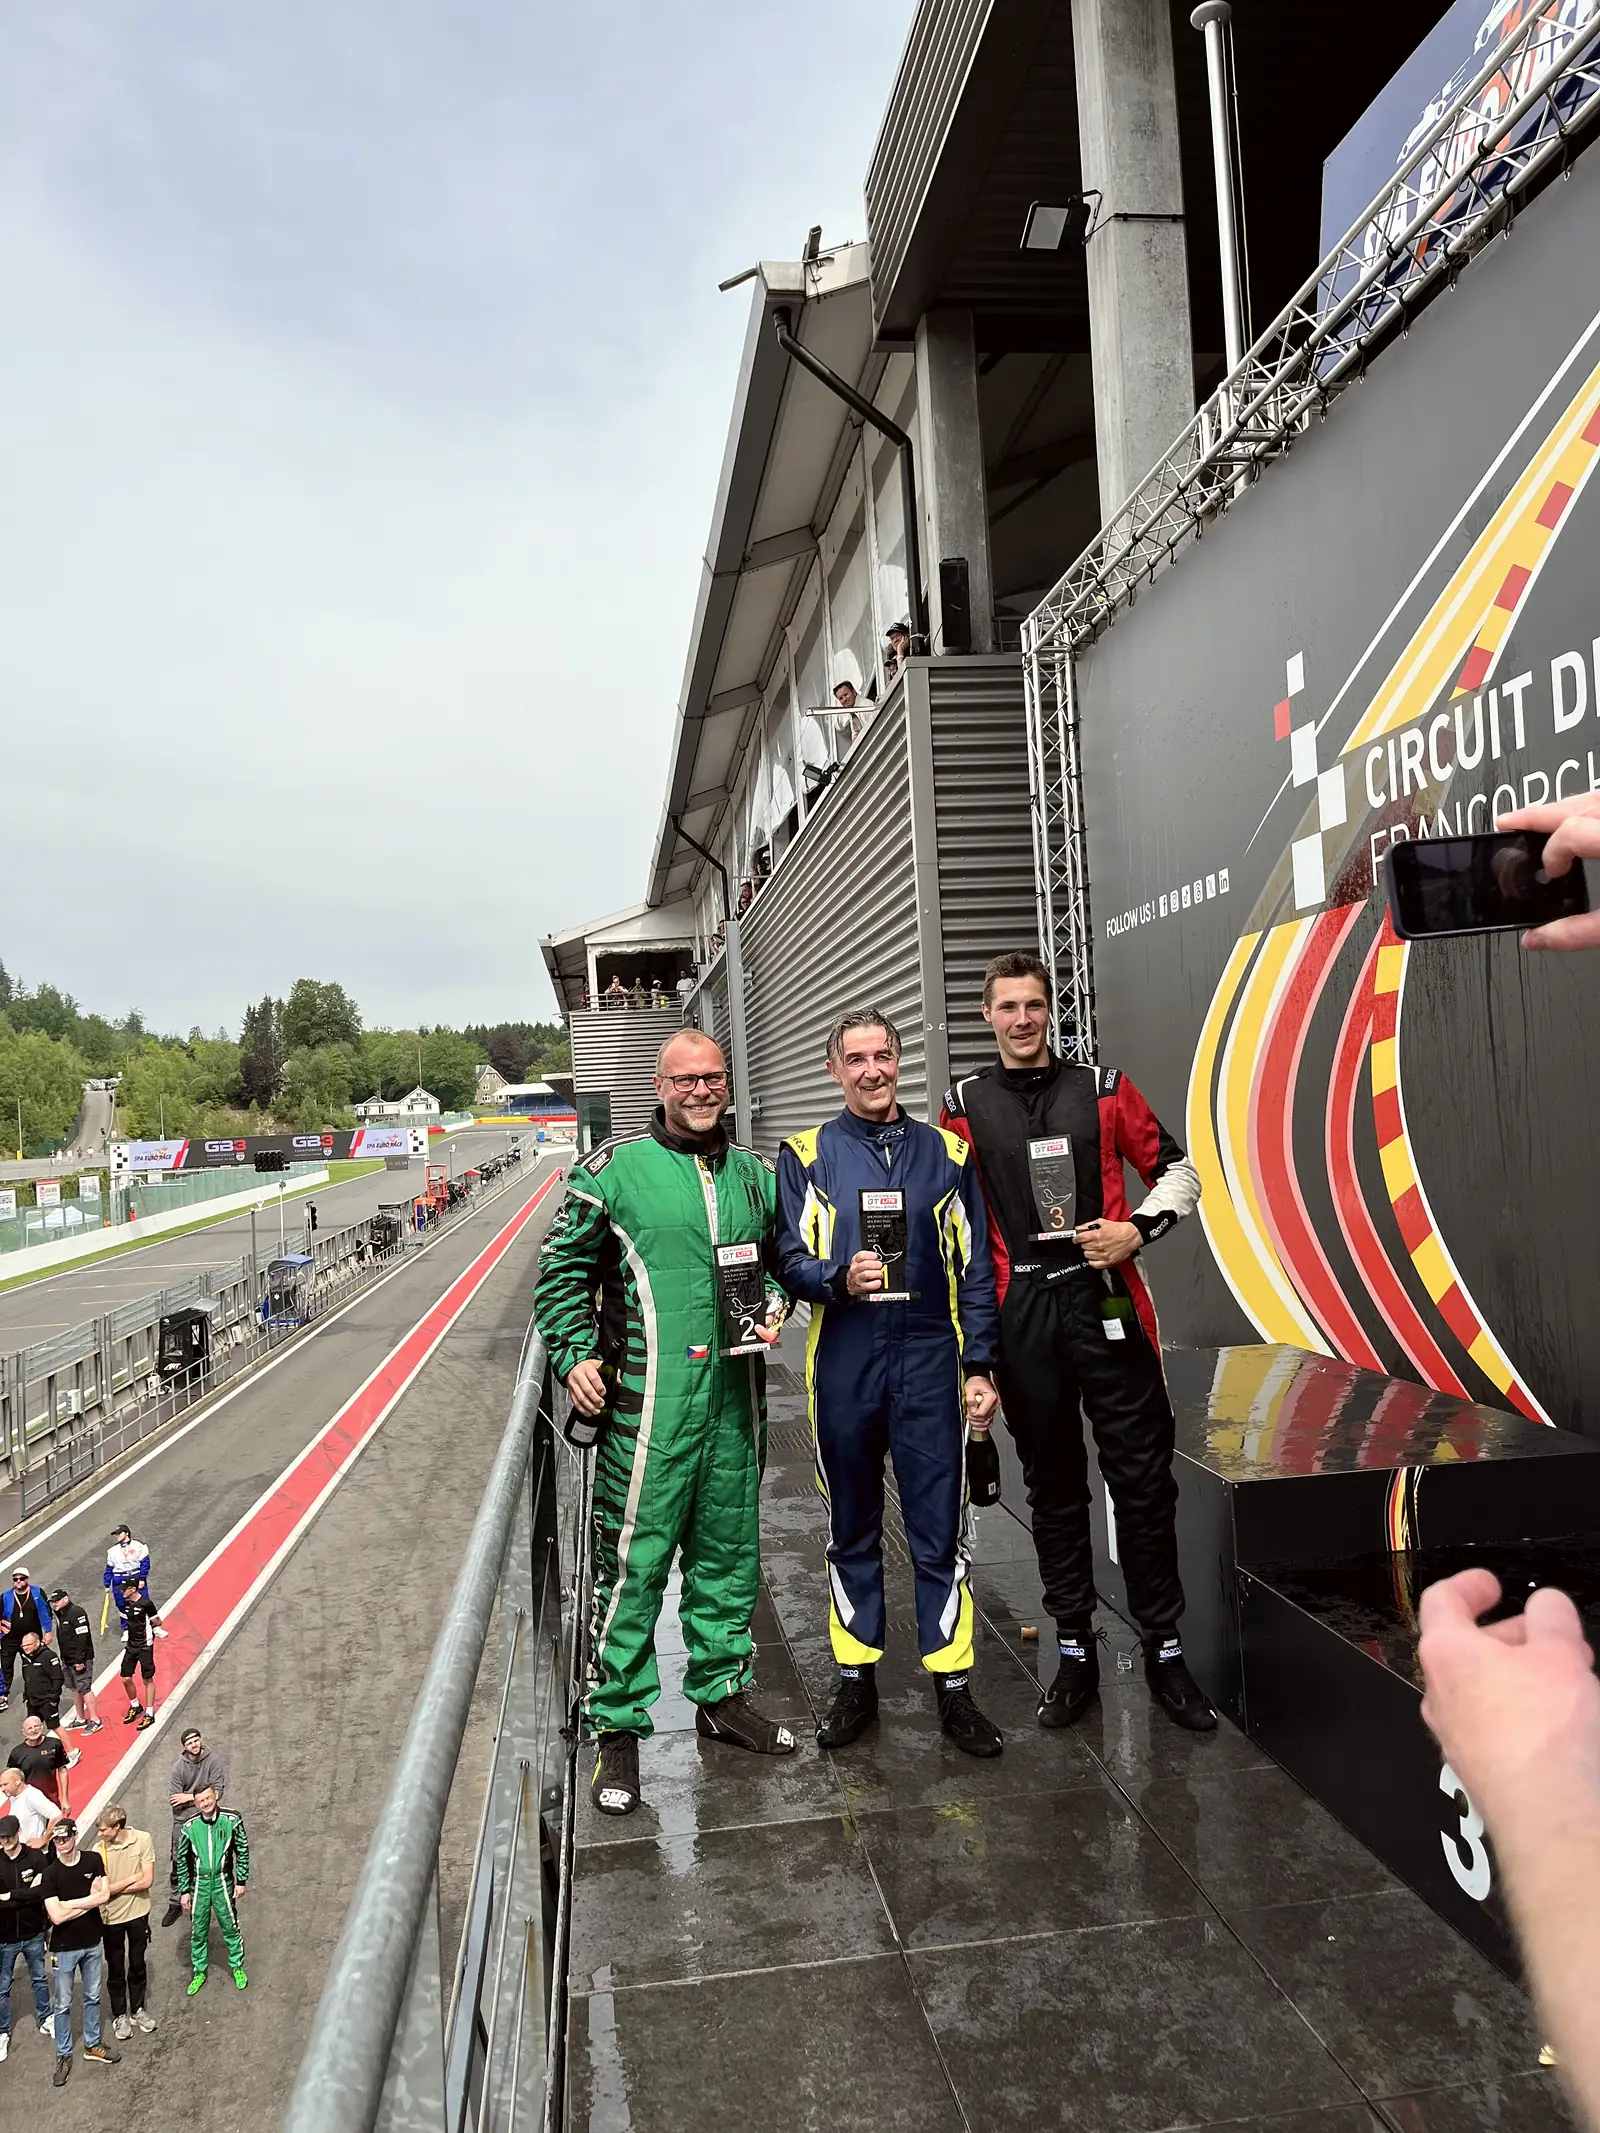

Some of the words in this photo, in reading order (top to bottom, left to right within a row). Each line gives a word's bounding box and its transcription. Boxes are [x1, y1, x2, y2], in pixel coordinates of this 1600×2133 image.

[1365, 670, 1533, 809] CIRCUIT
[1550, 636, 1600, 735] D
[1106, 907, 1138, 939] FOLLOW
[204, 1139, 247, 1153] GB3
[292, 1134, 334, 1148] GB3
[1049, 1206, 1065, 1229] 3
[722, 1252, 735, 1260] GT
[881, 1263, 889, 1289] 1
[739, 1316, 757, 1342] 2
[599, 1790, 631, 1806] OMP
[1439, 1763, 1491, 1901] 3
